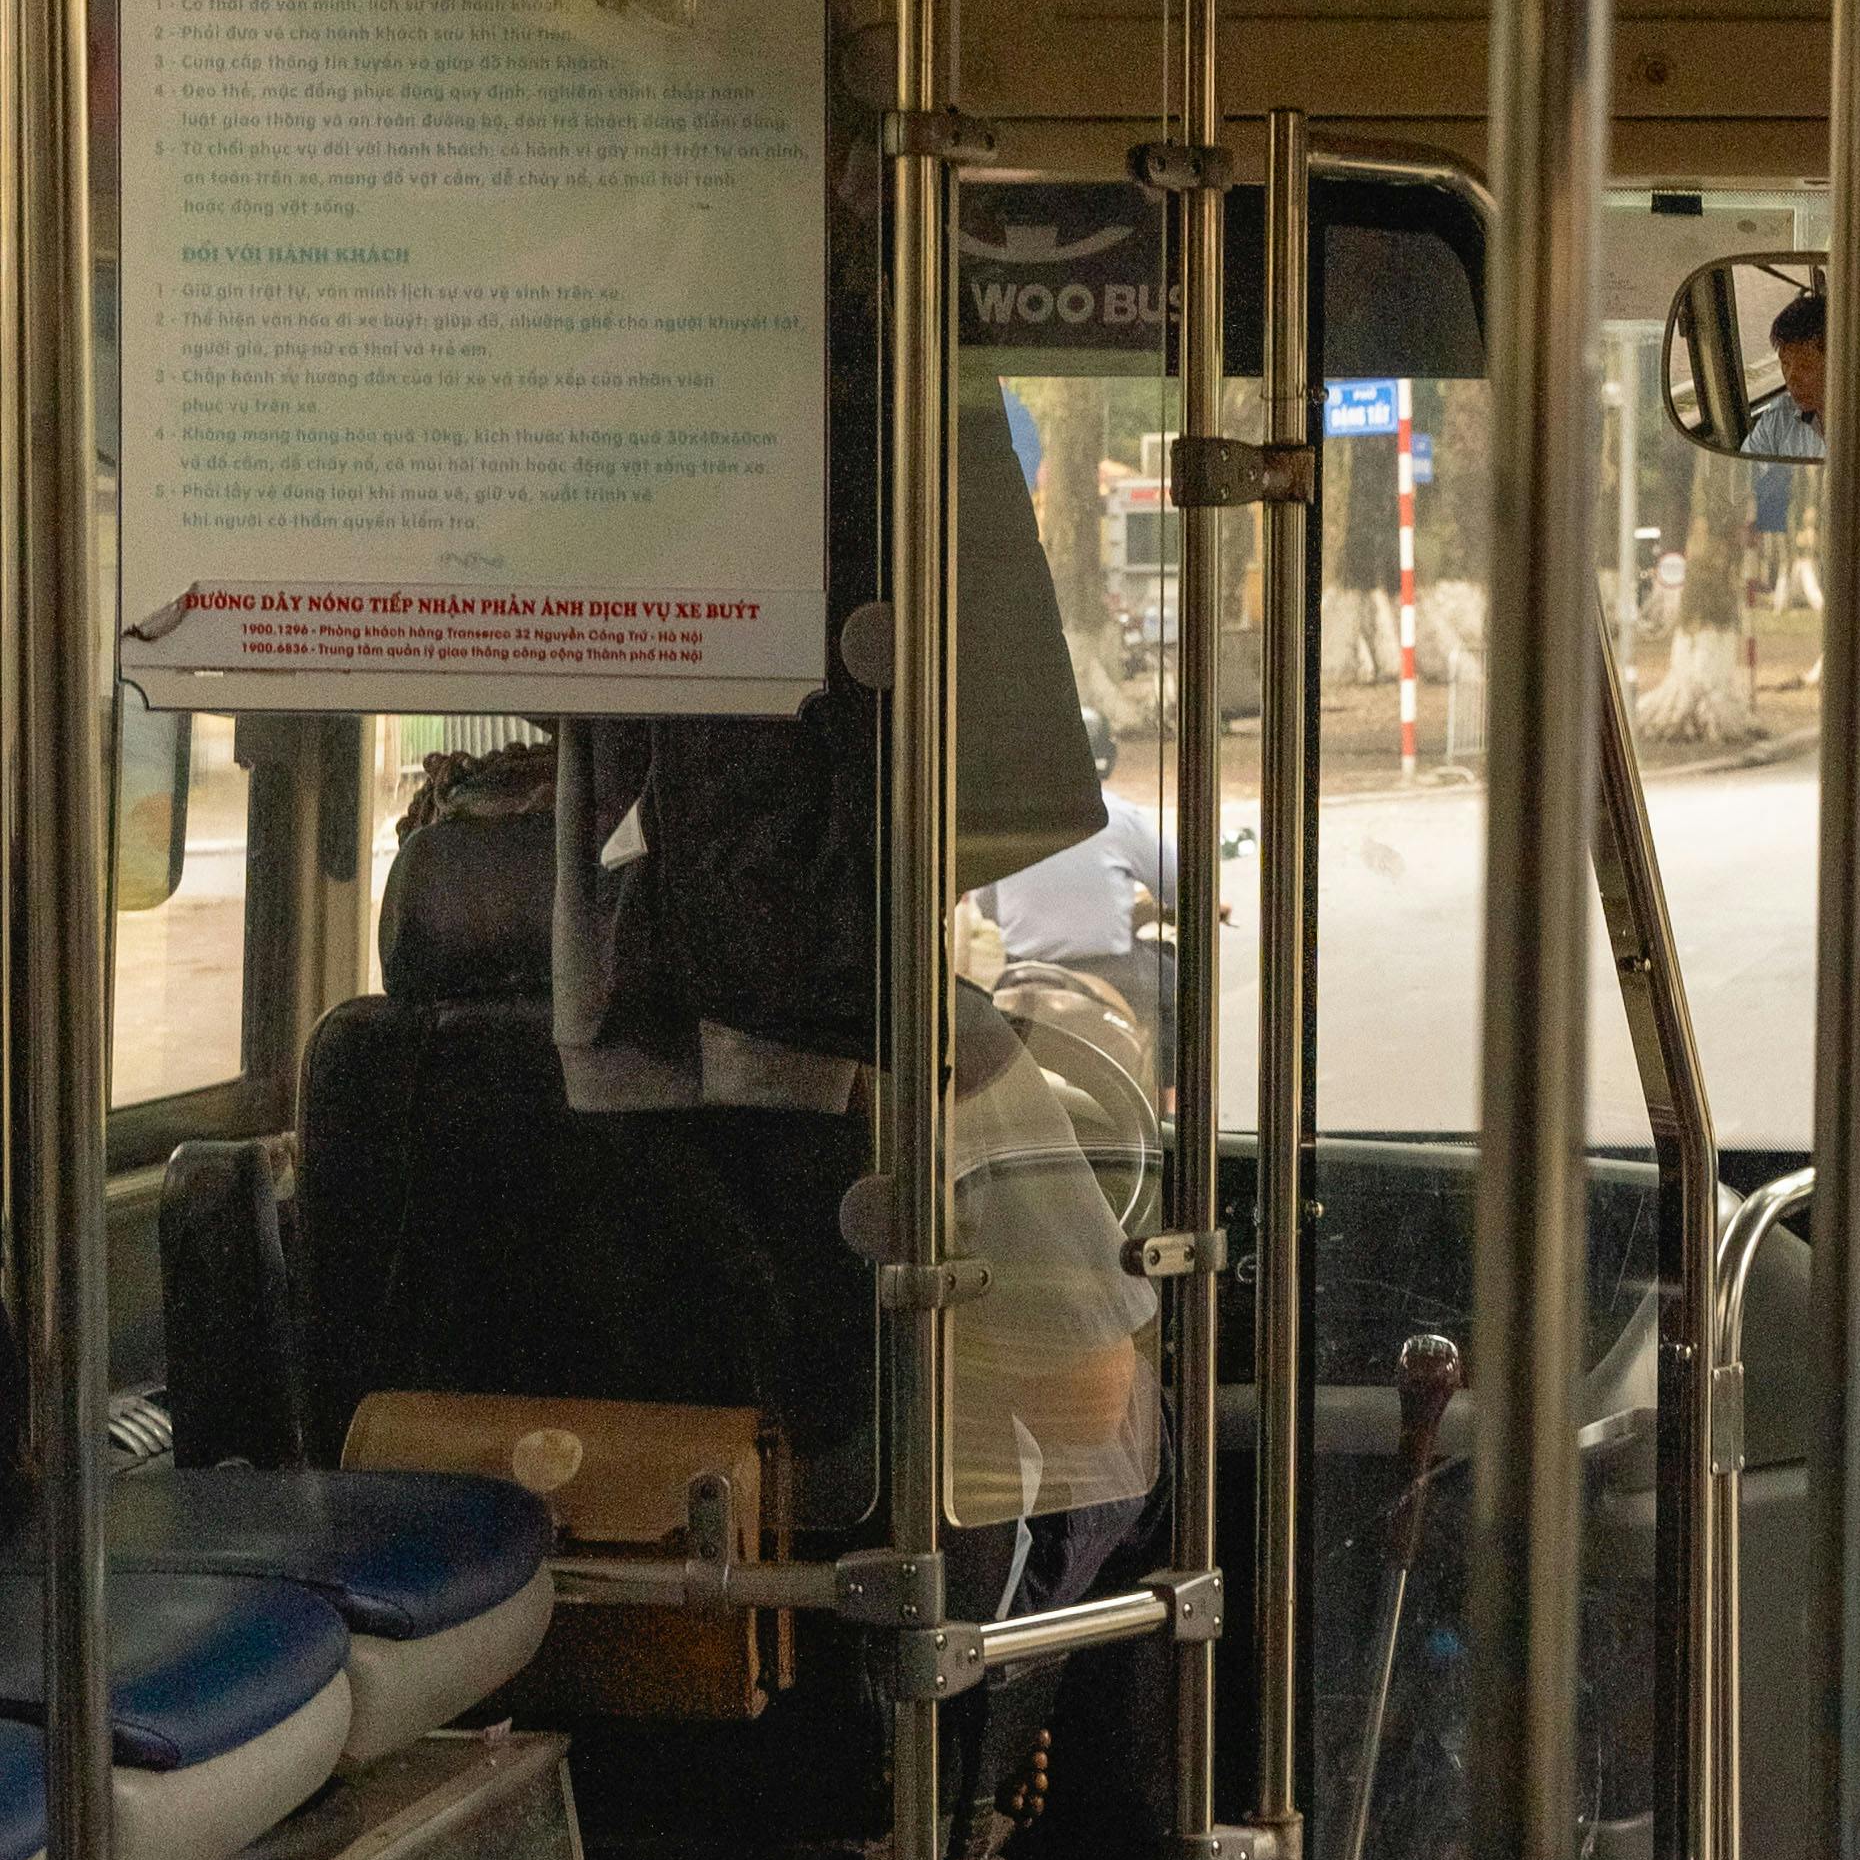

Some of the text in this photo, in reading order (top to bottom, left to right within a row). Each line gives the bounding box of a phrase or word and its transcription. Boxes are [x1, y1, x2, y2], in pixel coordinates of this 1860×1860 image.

[970, 283, 1095, 324] WOO
[261, 592, 303, 611] DÂY
[308, 592, 364, 613] NÓNG
[370, 591, 413, 614] TIẾP
[418, 595, 476, 618] NHẬN
[481, 594, 536, 615] PHẢN
[589, 601, 637, 621] DỊCH
[642, 602, 670, 621] VỤ
[676, 603, 701, 619] XE
[706, 599, 760, 619] BUÝT
[242, 624, 308, 635] 1900.1296
[320, 624, 361, 639] Phòng
[365, 625, 405, 637] khách
[410, 626, 443, 640] hàng
[515, 629, 530, 639] 32
[535, 627, 584, 642] Nguyễn
[589, 629, 624, 643] Công
[659, 631, 676, 642] Hà
[682, 631, 702, 644] Nội
[319, 643, 354, 657] Trung
[358, 643, 383, 655] tâm
[387, 644, 421, 658] quản
[438, 646, 468, 659] giao
[472, 646, 508, 660] thông
[513, 647, 546, 661] công
[588, 649, 626, 660] Thành
[630, 649, 655, 663] phố
[659, 651, 676, 661] Hà
[682, 651, 702, 663] Nội
